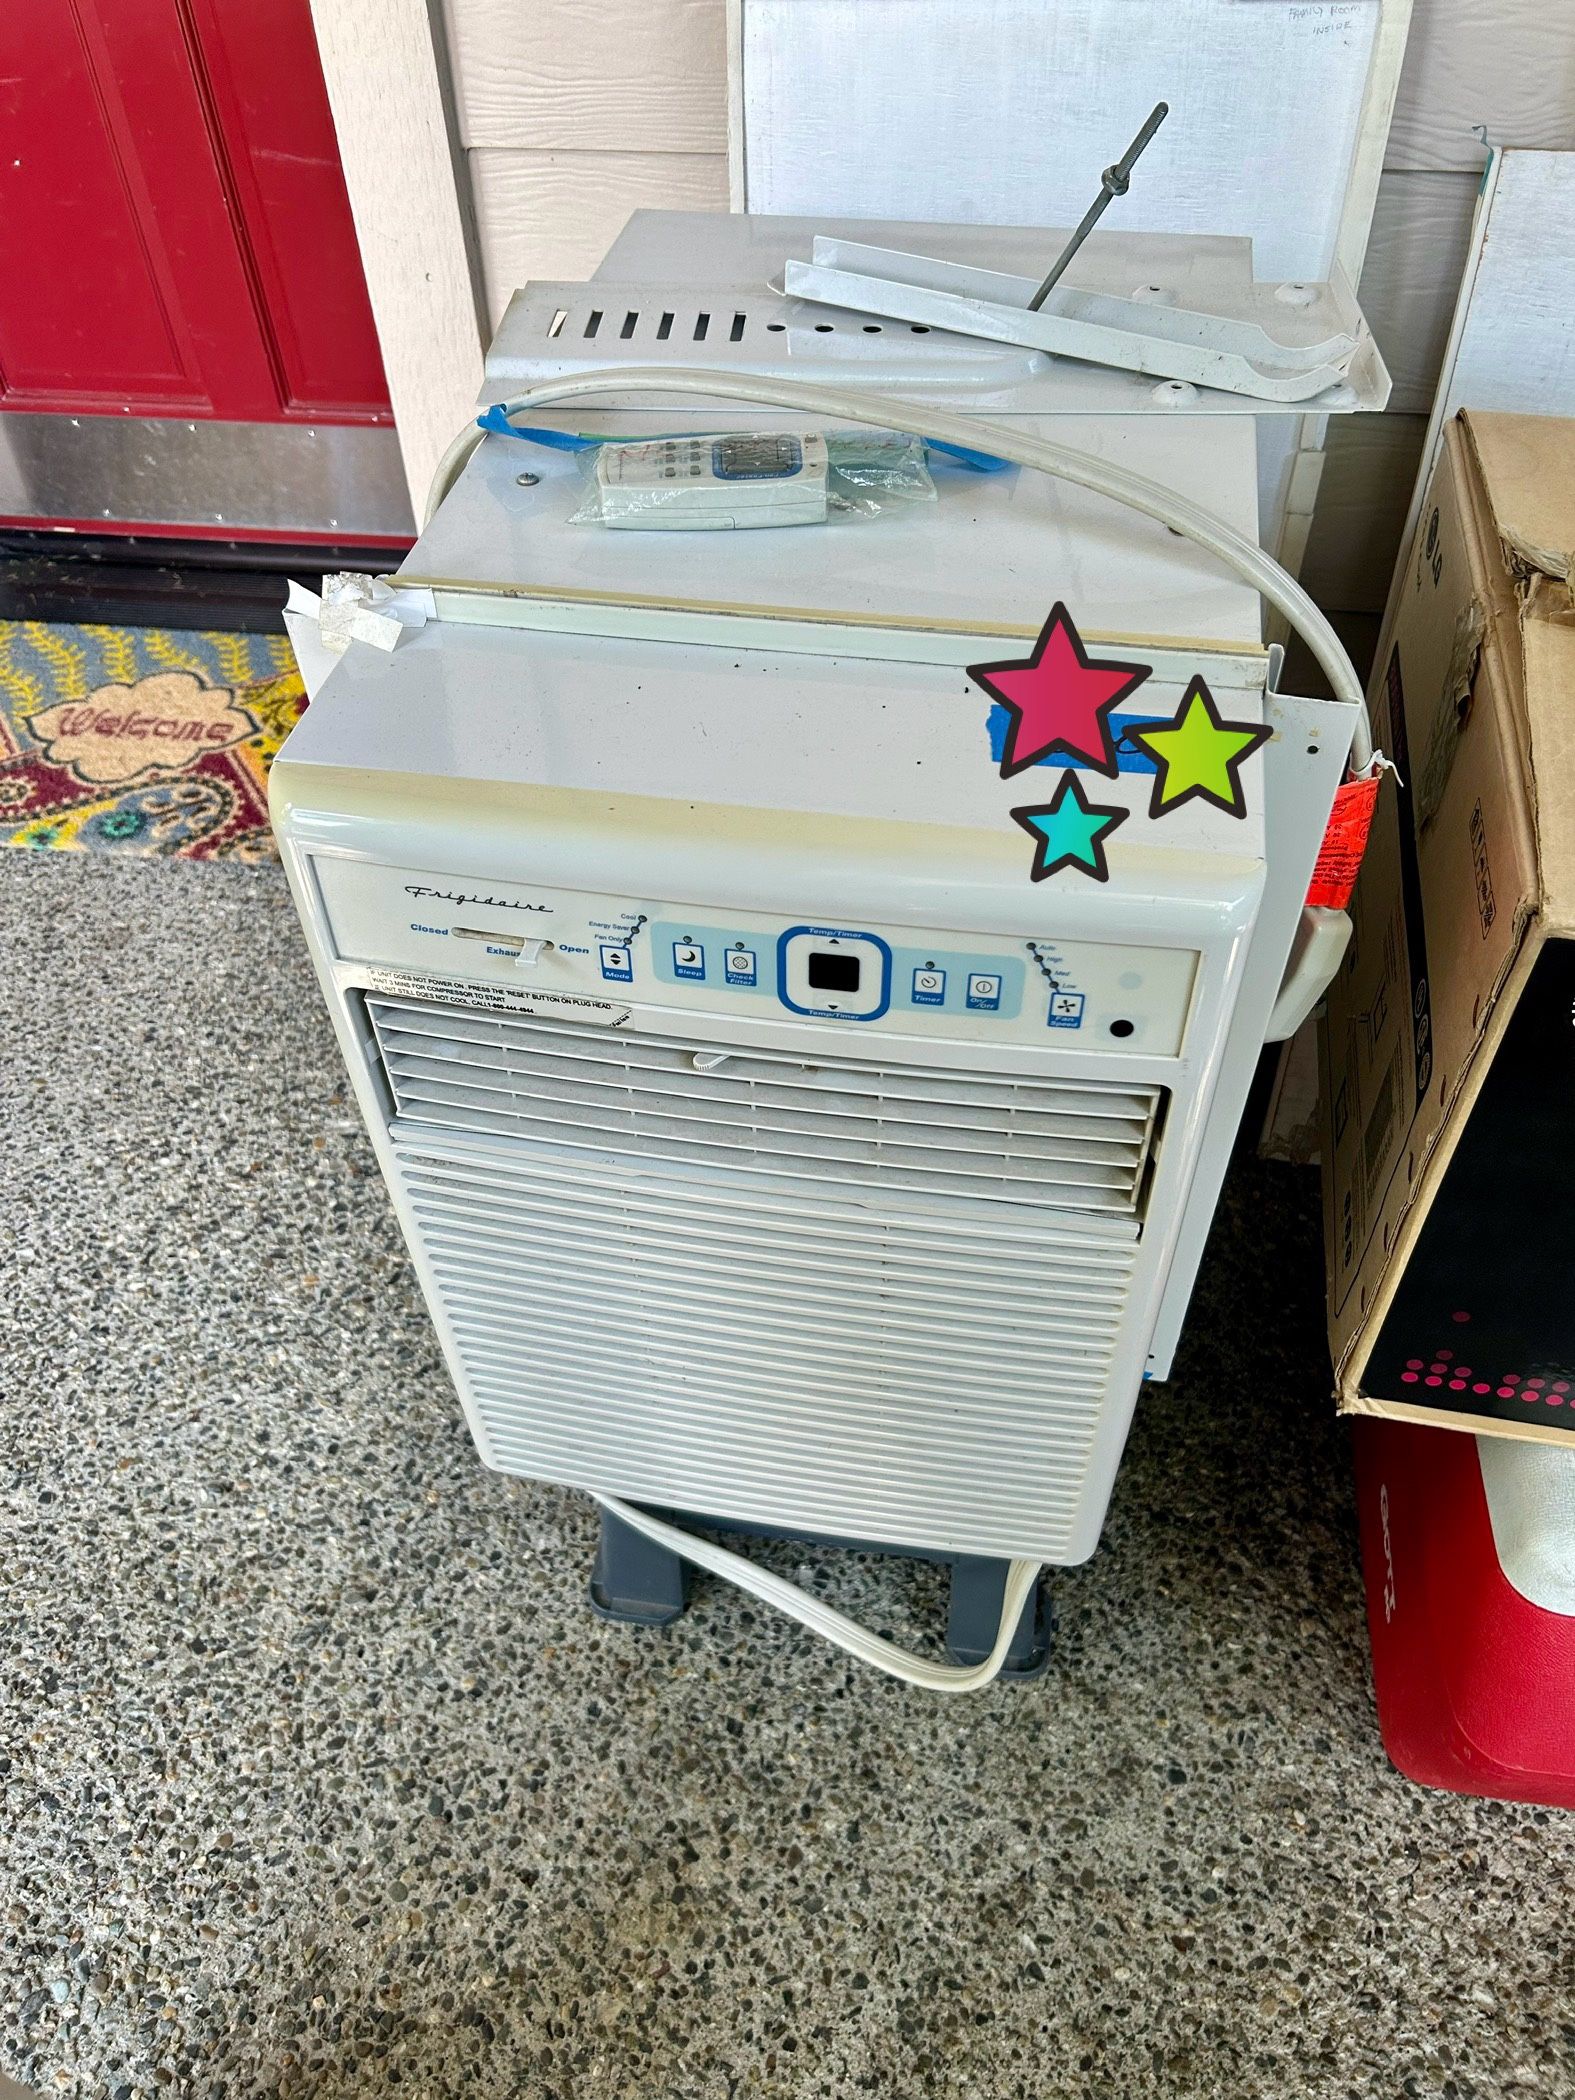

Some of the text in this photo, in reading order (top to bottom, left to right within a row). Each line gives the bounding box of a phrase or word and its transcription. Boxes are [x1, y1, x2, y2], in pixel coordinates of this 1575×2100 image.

[1312, 21, 1352, 35] INSIDE
[58, 706, 235, 742] Welcome
[404, 885, 554, 913] Frigidaire
[620, 913, 637, 921] Cool
[410, 923, 449, 936] Closed
[588, 921, 630, 932] Energy Saver
[594, 933, 624, 944] Fan Only
[808, 927, 863, 939] Temp/Timer
[486, 946, 521, 958] Exhau
[559, 944, 590, 955] Open
[1038, 943, 1057, 951] Auto
[605, 971, 630, 980] Mode
[677, 968, 703, 977] Sleep
[727, 972, 754, 980] Check
[729, 978, 753, 986] Filter
[394, 973, 412, 981] DOES
[428, 978, 453, 987] POWER
[468, 984, 491, 993] PRESS
[491, 987, 505, 995] THE
[532, 993, 560, 1003] BUTTON
[561, 997, 572, 1005] ON
[573, 999, 591, 1008] PLUG
[394, 980, 411, 988] MINS
[427, 985, 474, 998] COMPRESSOR
[485, 994, 505, 1003] START
[397, 988, 415, 996] STILL
[416, 990, 434, 999] DOES
[435, 993, 449, 1001] NOT
[914, 995, 942, 1004] Timer
[808, 1010, 861, 1020] Temp/Timer
[1050, 1020, 1079, 1028] Speed
